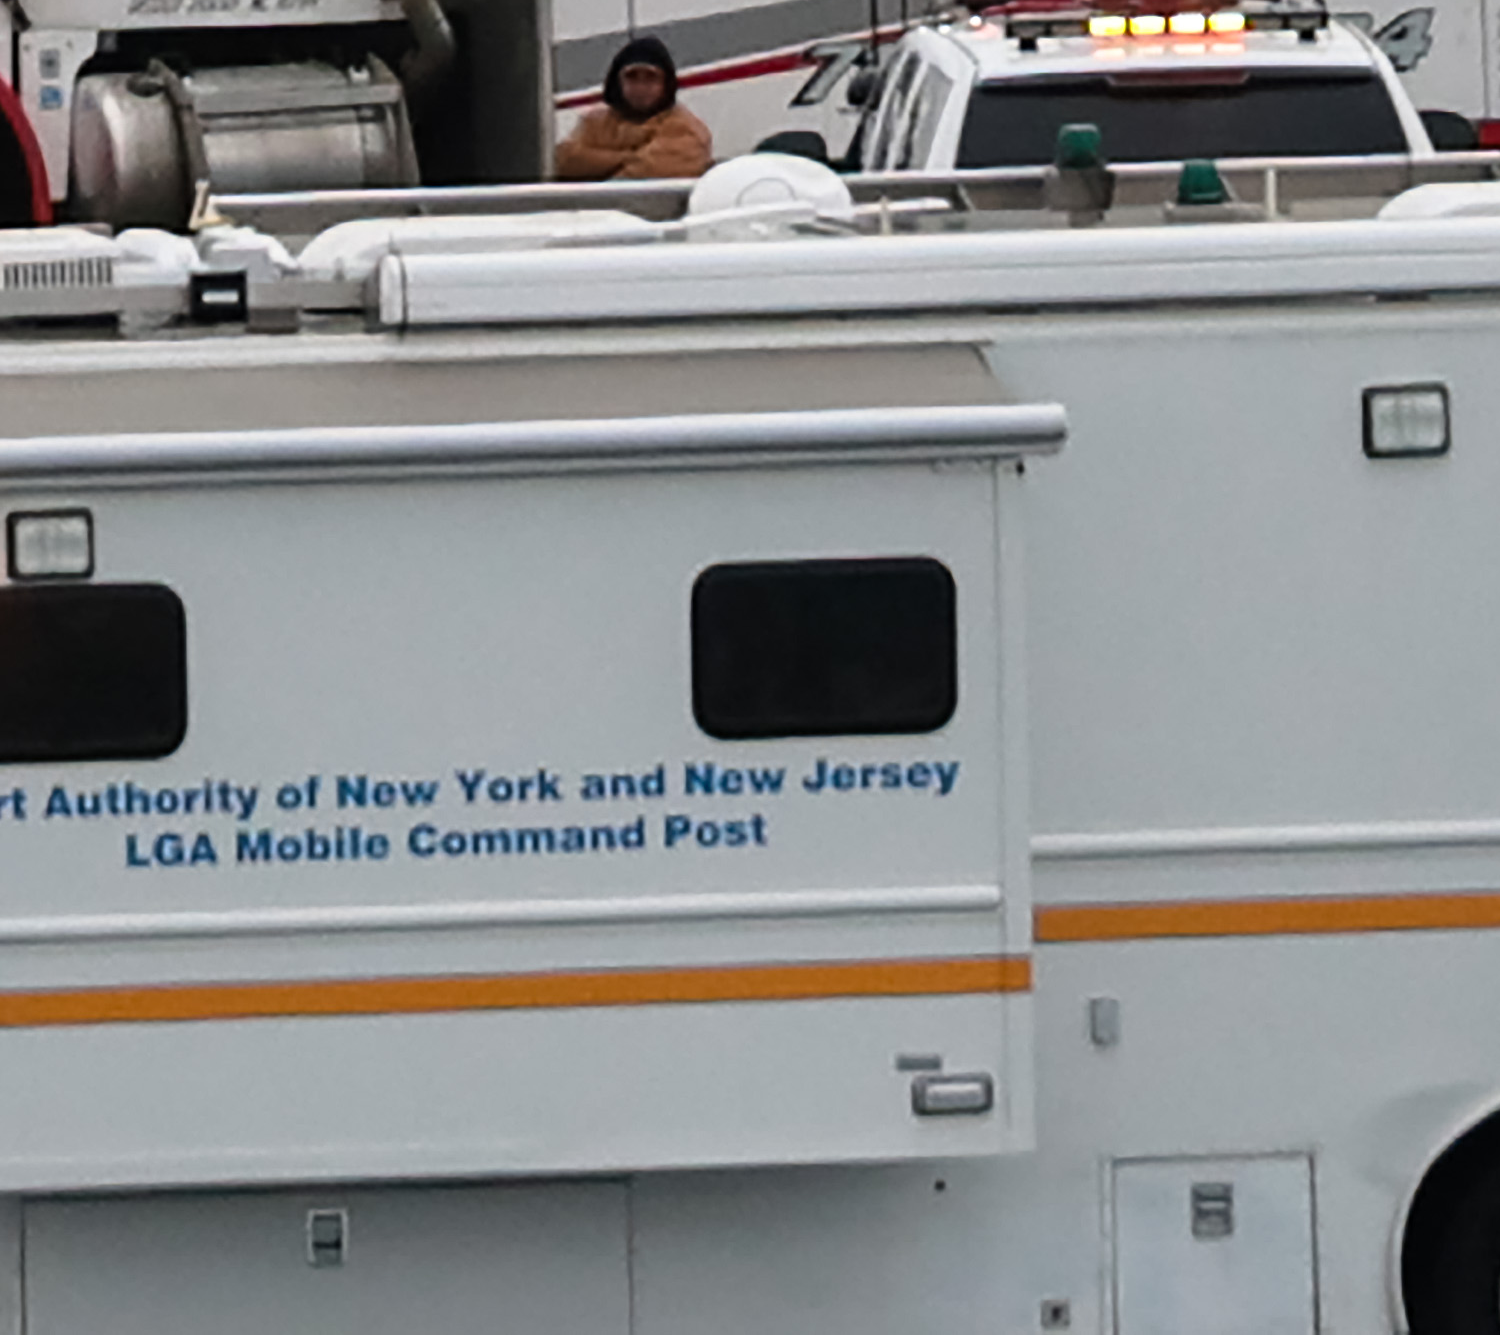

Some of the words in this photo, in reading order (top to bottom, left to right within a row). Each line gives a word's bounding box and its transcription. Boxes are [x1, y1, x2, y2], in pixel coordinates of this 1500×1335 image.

[44, 779, 258, 821] Authority
[276, 775, 321, 810] of
[336, 773, 438, 808] New
[455, 768, 562, 804] York
[580, 763, 666, 800] and
[683, 761, 787, 796] New
[801, 757, 961, 797] Jersey
[124, 831, 219, 868] LGA
[235, 825, 391, 865] Mobile
[406, 815, 647, 861] Command
[663, 813, 769, 849] Post
